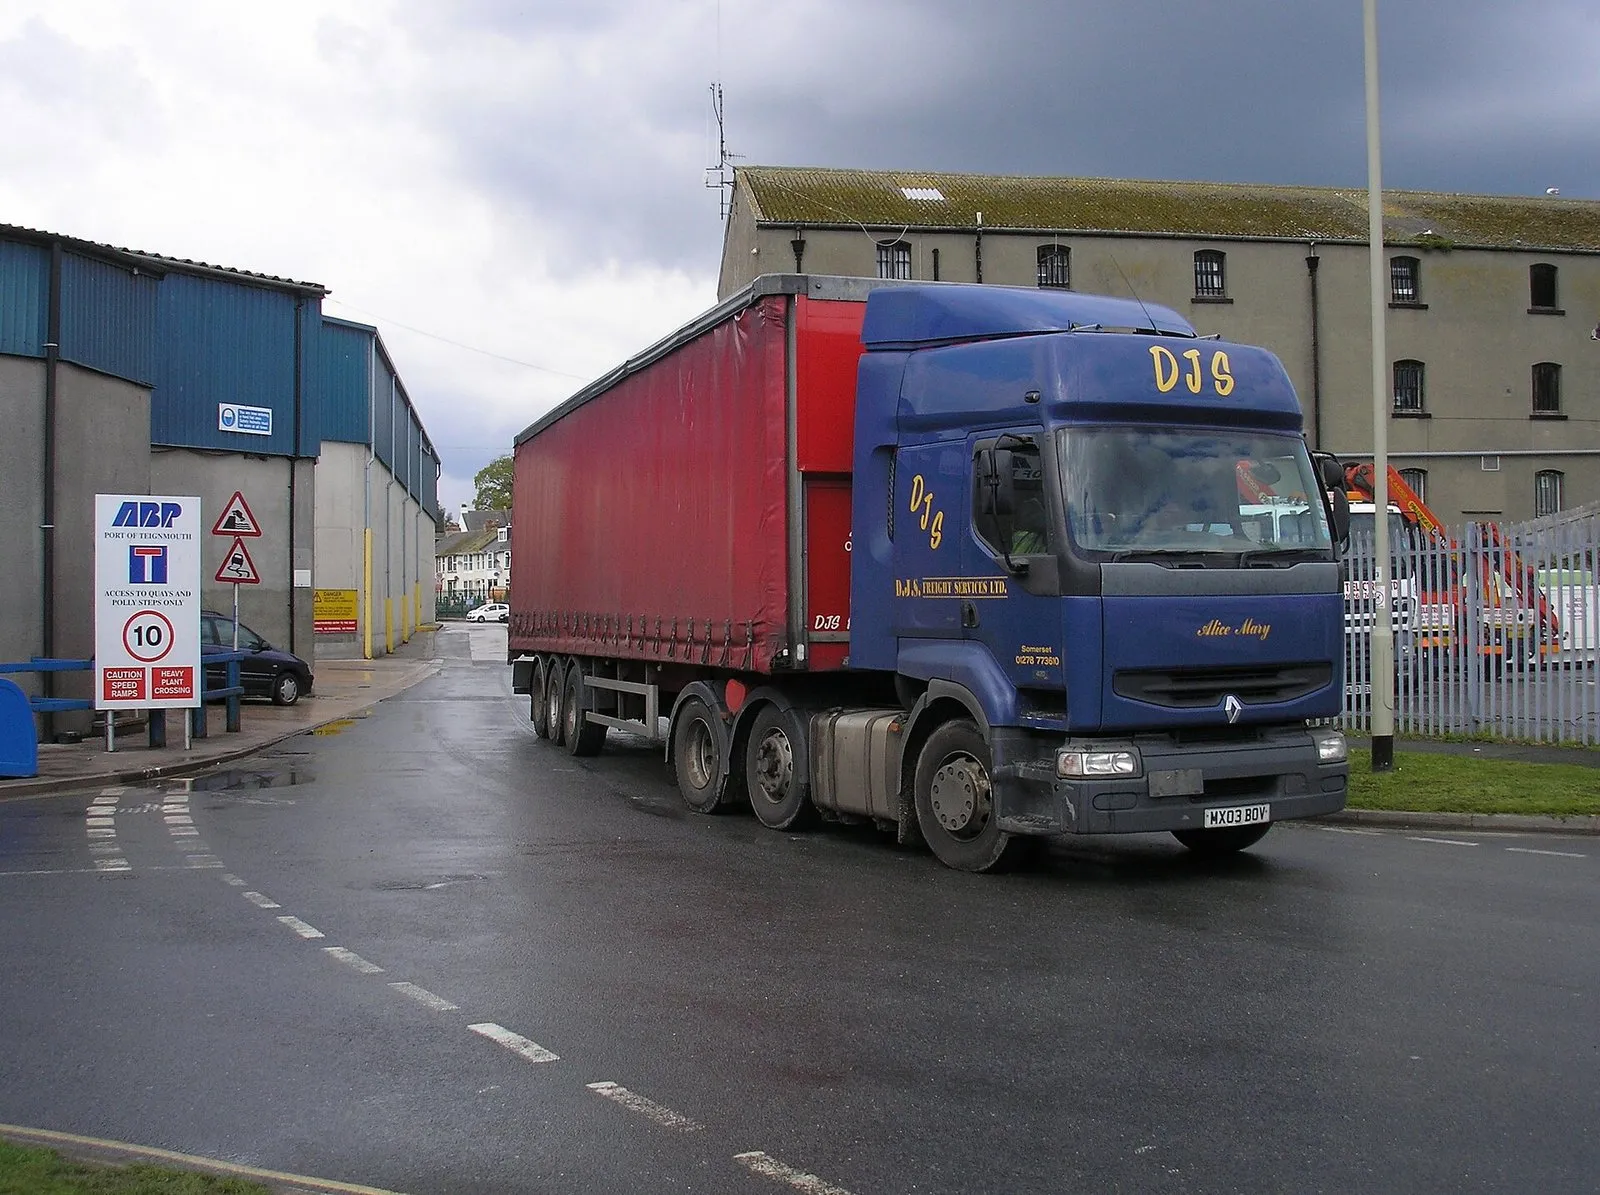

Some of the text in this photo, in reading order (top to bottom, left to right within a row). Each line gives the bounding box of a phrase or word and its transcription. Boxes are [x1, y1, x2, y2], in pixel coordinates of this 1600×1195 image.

[1149, 346, 1234, 396] DJS
[111, 501, 182, 528] ABP
[910, 474, 944, 550] DJS
[148, 590, 174, 598] QUAYS
[922, 581, 952, 594] FREIGHT
[954, 581, 988, 594] SERVICES
[814, 615, 840, 630] DJS
[1197, 618, 1271, 640] Alice Mary
[134, 626, 162, 646] 10
[1021, 645, 1052, 653] Somerset
[106, 671, 142, 679] CAUTION
[154, 686, 191, 694] CROSSING
[1210, 809, 1242, 825] MX03
